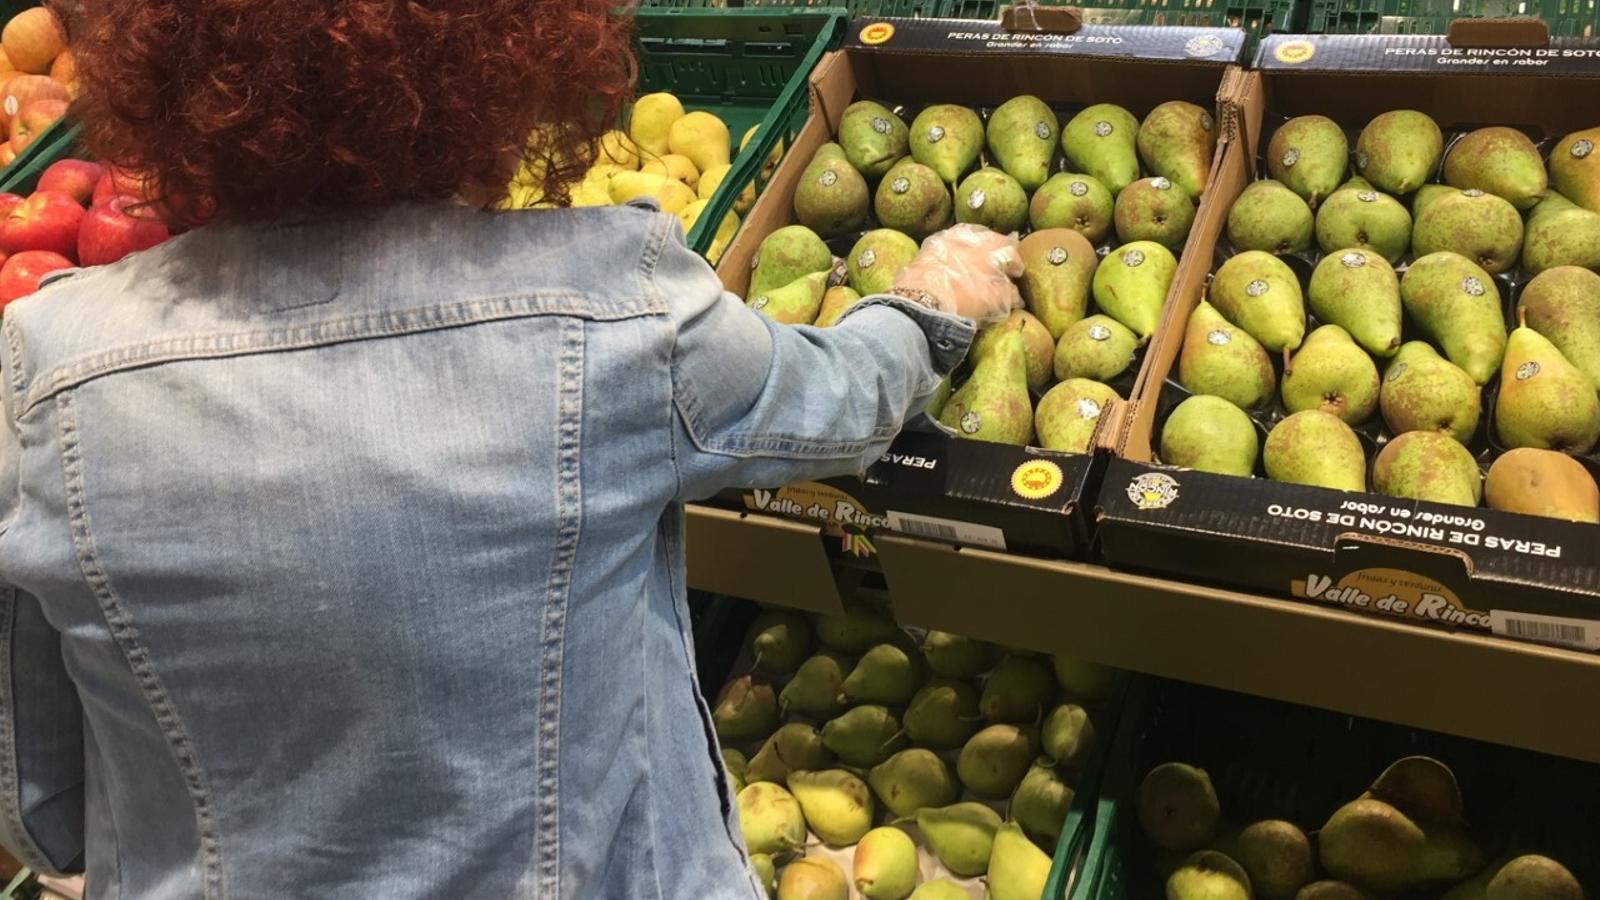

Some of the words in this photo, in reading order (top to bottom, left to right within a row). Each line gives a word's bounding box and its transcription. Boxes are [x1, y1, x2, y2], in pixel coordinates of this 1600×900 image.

[947, 32, 990, 40] PERAS
[992, 33, 1010, 41] DE
[1012, 32, 1064, 42] RINCÓN
[1065, 35, 1085, 43] DE
[1086, 36, 1123, 44] SOTO
[1384, 48, 1438, 56] PERAS
[1441, 48, 1464, 56] DE
[1466, 47, 1532, 57] RINCÓN
[1535, 49, 1560, 57] DE
[1436, 56, 1490, 65] Grandes
[1512, 57, 1549, 66] sabor
[880, 453, 937, 469] PERAS
[753, 489, 802, 515] Valle
[807, 504, 829, 519] de
[1340, 500, 1386, 515] sabor
[1267, 504, 1322, 521] SOTO
[1326, 512, 1356, 527] DE
[1390, 507, 1411, 518] en
[1415, 511, 1485, 531] Grandes
[1359, 517, 1444, 541] RINCÓN
[1449, 531, 1480, 546] DE
[1484, 536, 1561, 558] PERAS
[1306, 574, 1371, 607] Valle
[1376, 595, 1409, 613] de
